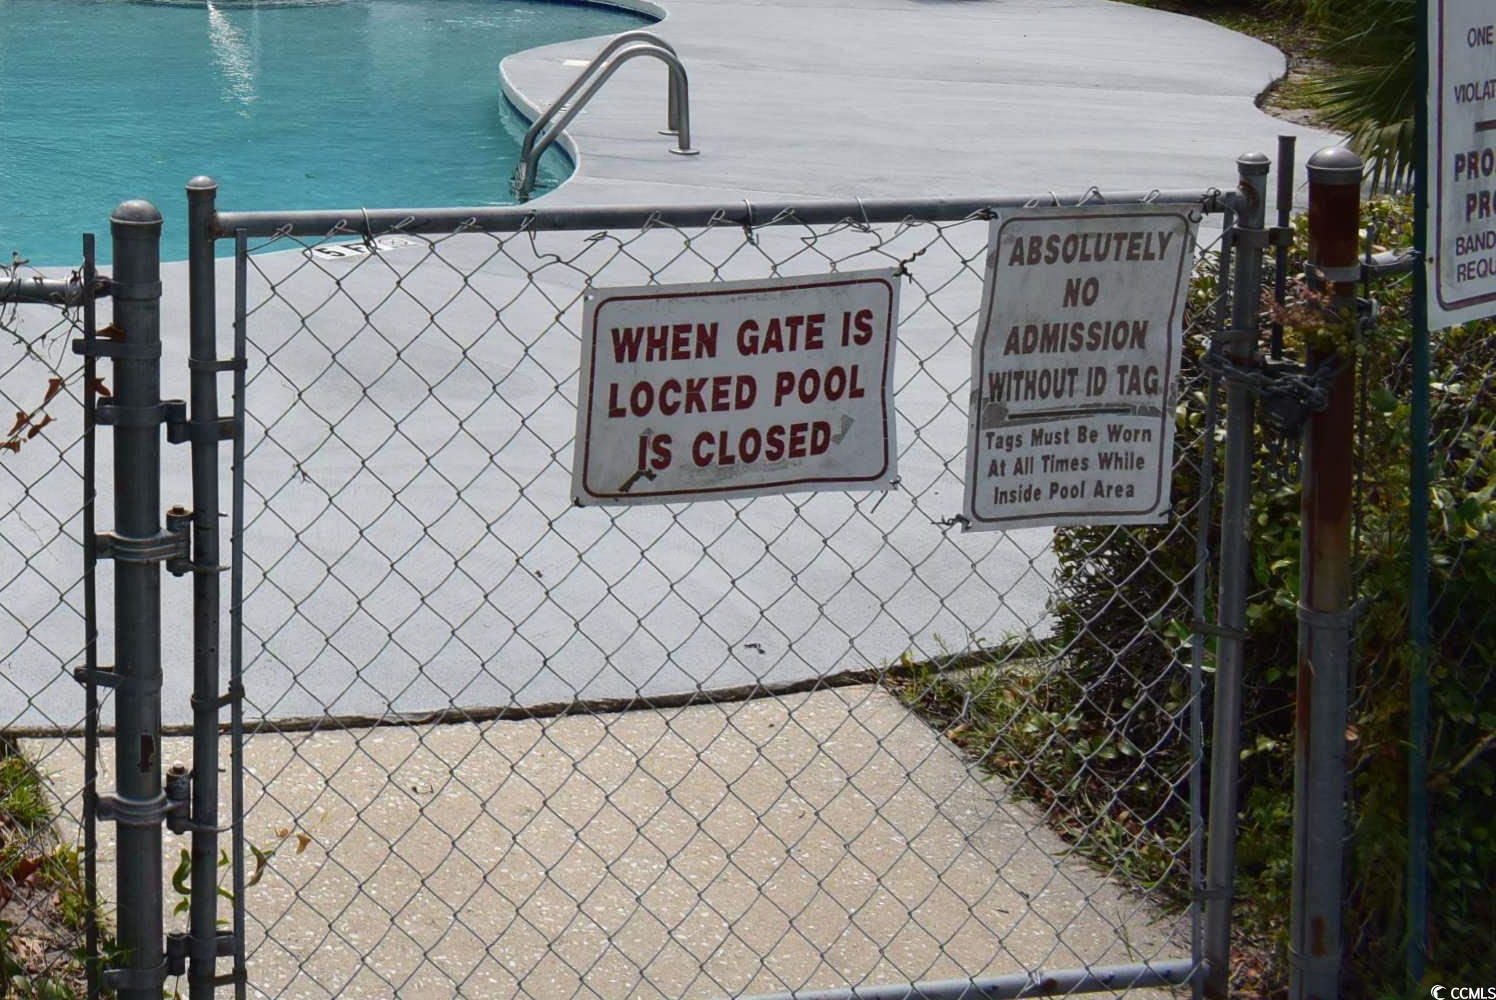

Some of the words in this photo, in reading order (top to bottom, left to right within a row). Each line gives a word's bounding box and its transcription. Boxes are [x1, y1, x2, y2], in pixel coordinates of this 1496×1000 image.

[1467, 25, 1494, 48] ONE
[1466, 190, 1496, 223] PR
[1008, 231, 1174, 267] ABSOLUTELY
[1062, 277, 1099, 308] NO
[611, 322, 719, 364] WHEN
[736, 314, 826, 356] GATE
[841, 309, 874, 347] IS
[1003, 320, 1149, 355] ADMISSION
[608, 374, 757, 419] LOCKED
[774, 364, 866, 407] POOL
[988, 367, 1079, 403] WITHOUT
[1085, 366, 1107, 397] ID
[1117, 365, 1160, 396] TAG
[638, 433, 673, 471] IS
[692, 420, 831, 467] CLOSED
[985, 431, 1023, 451] Tags
[1030, 428, 1070, 448] Must
[1077, 425, 1099, 445] Be
[1107, 424, 1152, 443] Worn
[988, 458, 1010, 478] At
[1013, 456, 1034, 476] All
[1041, 454, 1089, 473] Times
[1098, 451, 1145, 472] While
[994, 484, 1042, 505] Inside
[1049, 480, 1085, 500] Pool
[1093, 479, 1135, 499] Area
